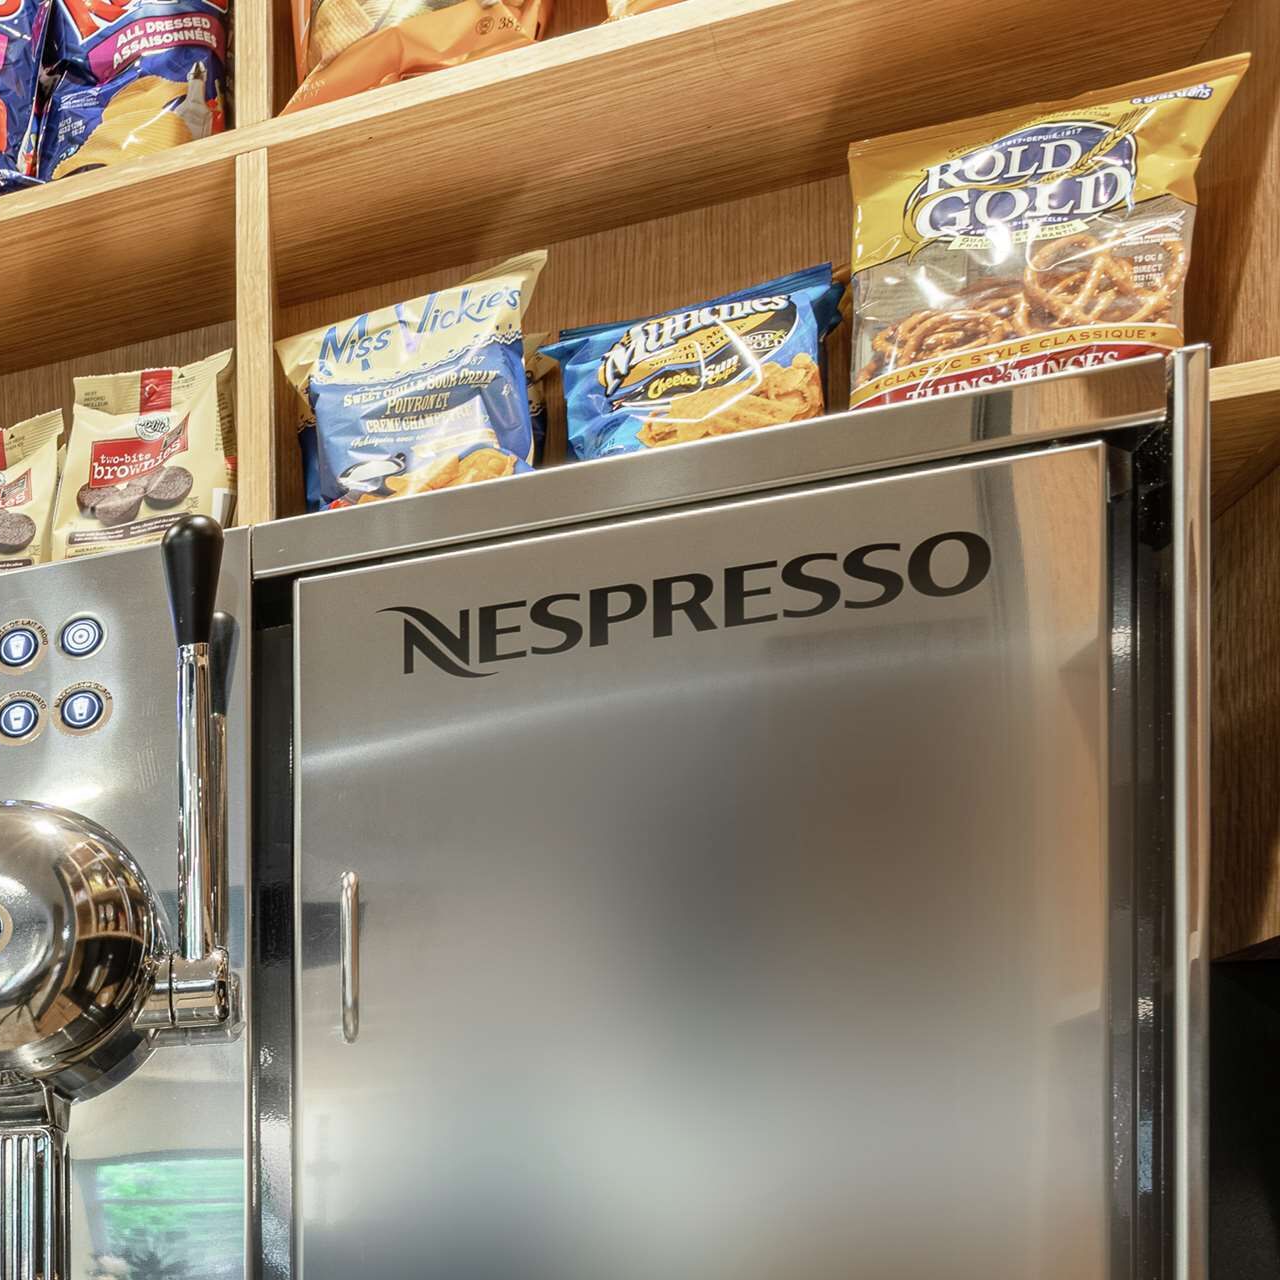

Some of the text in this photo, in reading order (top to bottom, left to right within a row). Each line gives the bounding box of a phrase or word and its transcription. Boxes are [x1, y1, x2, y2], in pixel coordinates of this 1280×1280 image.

[113, 29, 217, 68] ASSAISONNÉES
[117, 27, 144, 48] ALL
[145, 17, 210, 34] DRESSED
[921, 138, 1082, 198] ROLD
[915, 162, 1133, 240] GOLD
[393, 286, 521, 357] Vickie's
[647, 371, 699, 399] Cheetos
[883, 328, 1146, 387] CLASSIC STYLE CLASSIQUE
[93, 439, 181, 480] brownies
[376, 531, 992, 678] NESPRESSO
